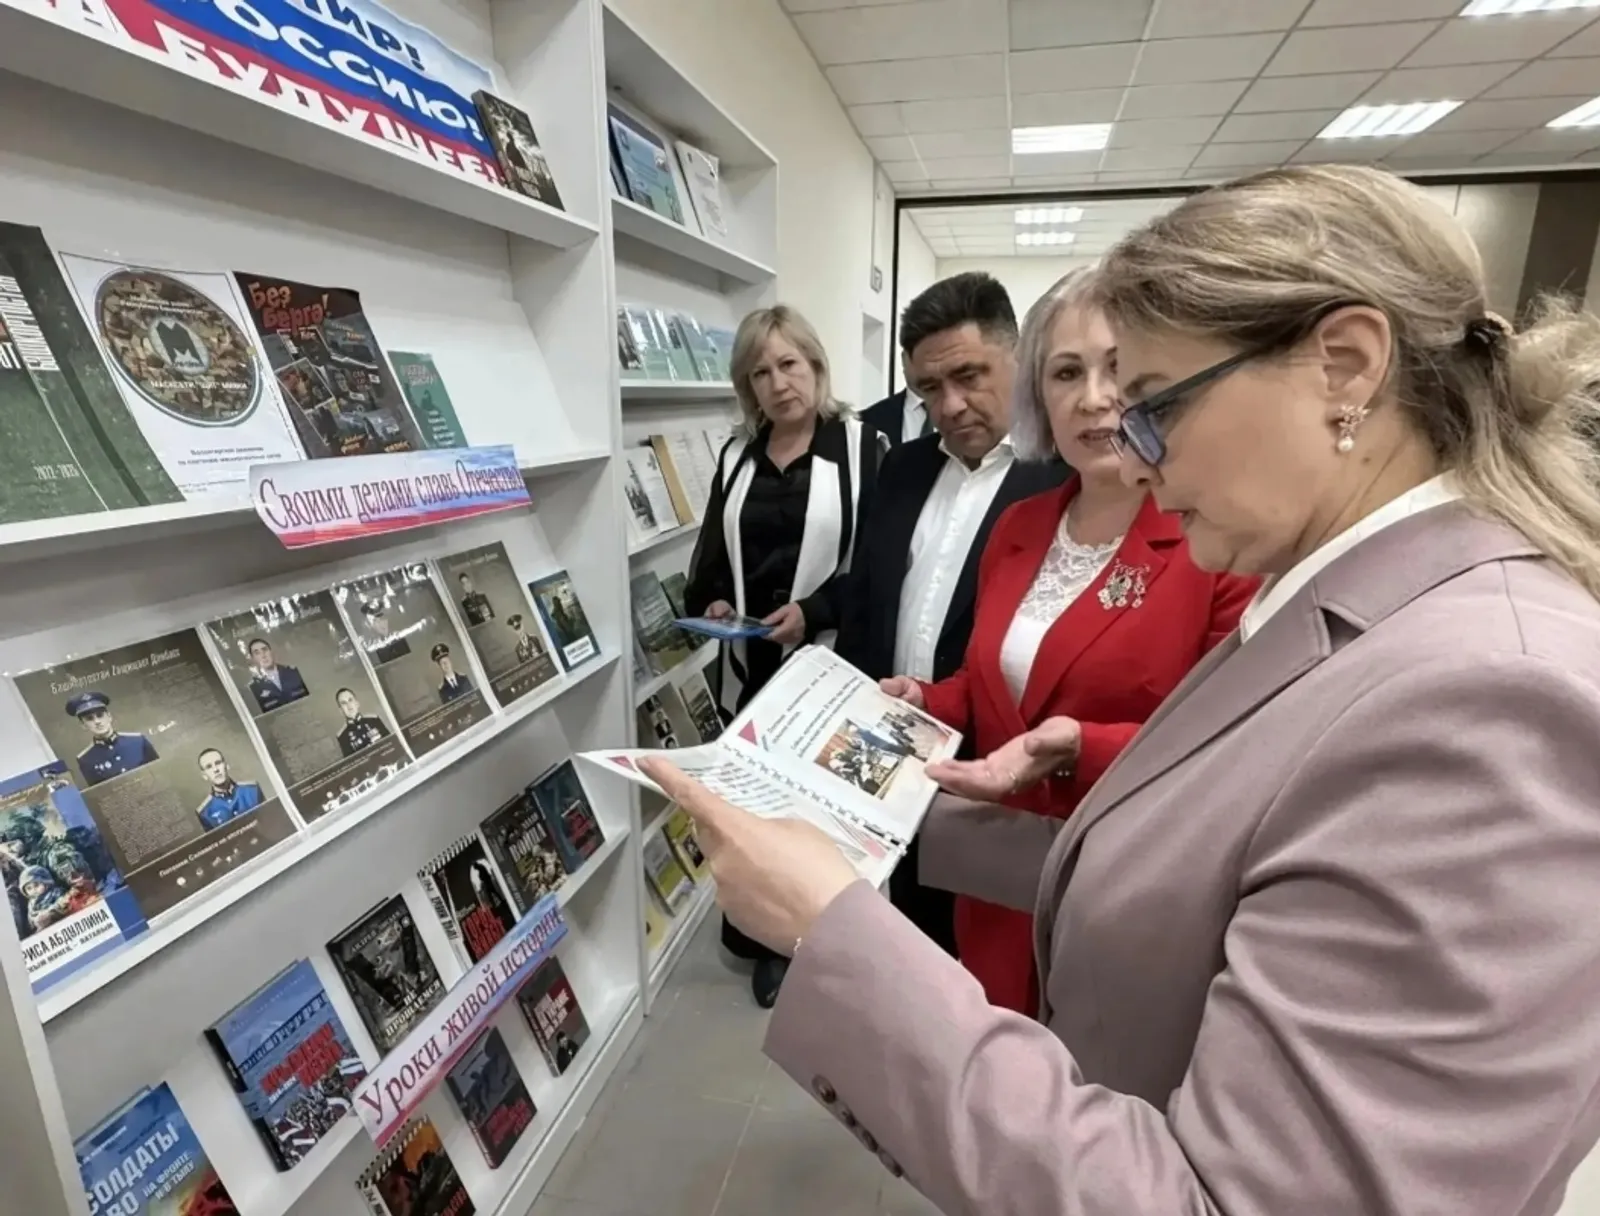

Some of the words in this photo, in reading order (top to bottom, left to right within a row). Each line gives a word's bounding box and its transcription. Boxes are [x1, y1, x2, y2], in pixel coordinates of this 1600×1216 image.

[299, 0, 426, 72] ИР!
[211, 0, 485, 141] ОССИЮ!
[248, 281, 291, 309] Без
[259, 478, 352, 529] Своими
[352, 480, 417, 523] делами
[415, 472, 460, 503] славь
[48, 908, 110, 949] АБДУЛЛИНА
[359, 1036, 443, 1125] Уроки
[441, 963, 500, 1047] живой
